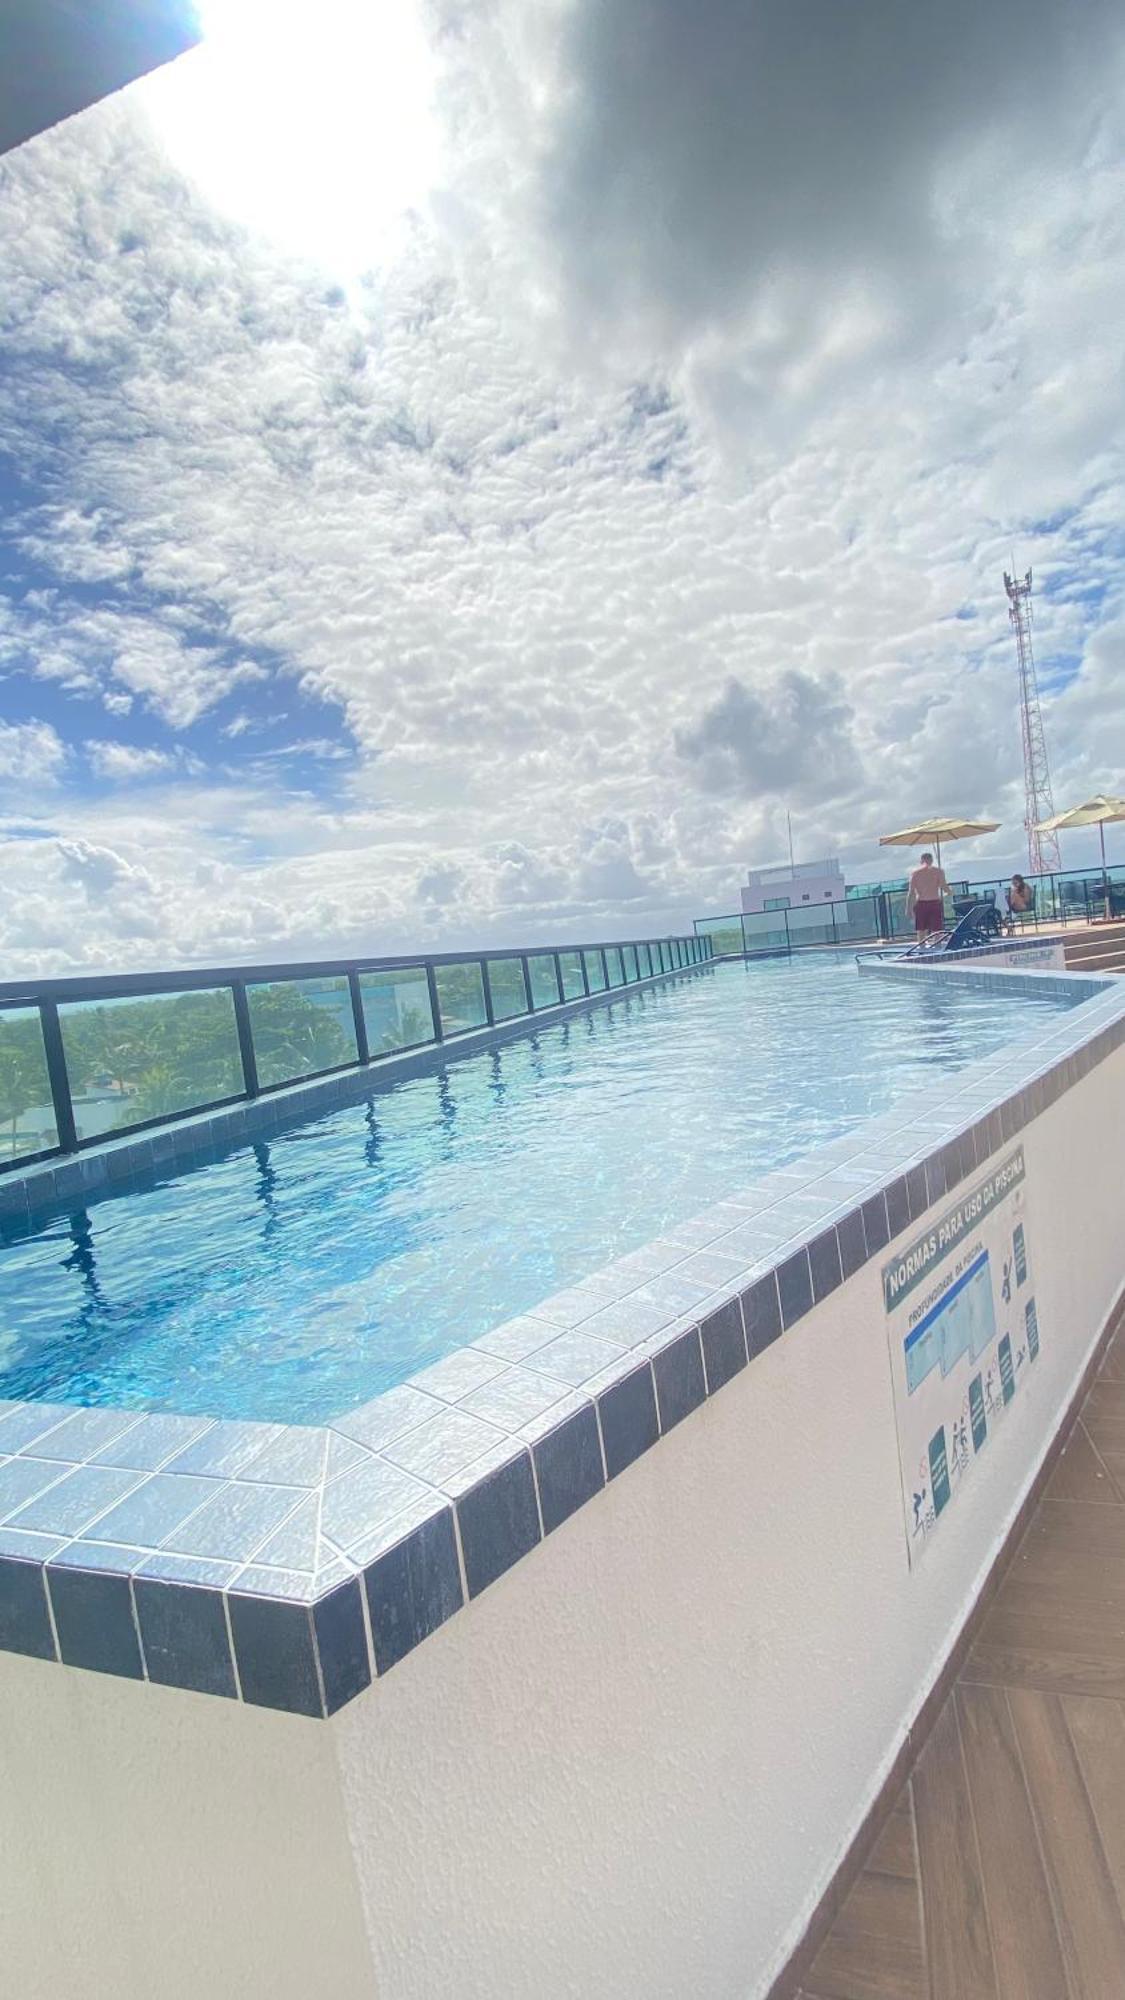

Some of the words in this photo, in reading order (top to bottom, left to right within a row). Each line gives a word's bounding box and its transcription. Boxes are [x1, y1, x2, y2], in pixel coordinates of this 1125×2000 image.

[889, 1235, 937, 1297] NORMAS
[939, 1214, 964, 1249] PARA
[964, 1194, 982, 1223] USO
[983, 1182, 994, 1203] DA
[995, 1156, 1023, 1193] PISCINA
